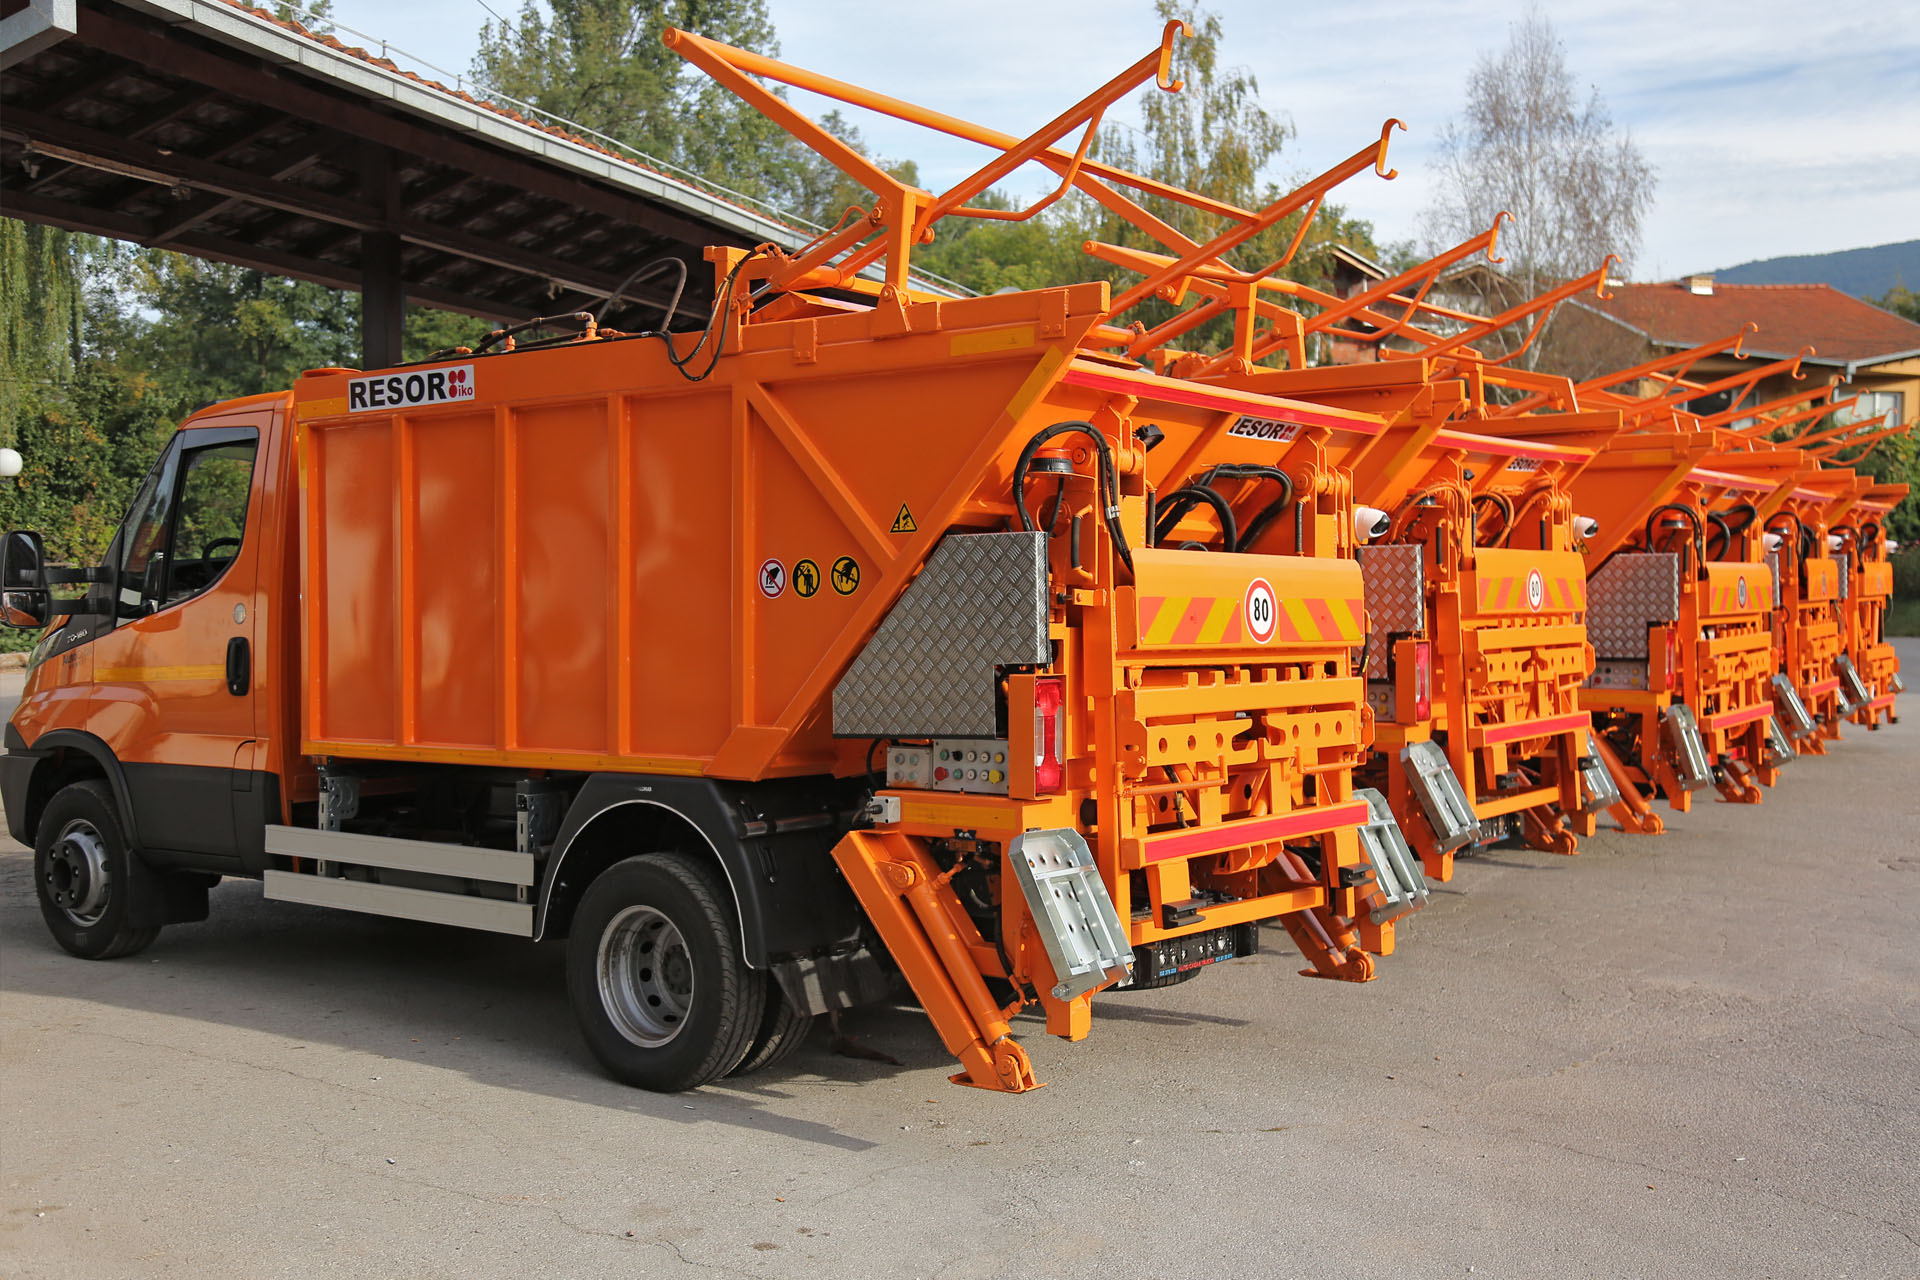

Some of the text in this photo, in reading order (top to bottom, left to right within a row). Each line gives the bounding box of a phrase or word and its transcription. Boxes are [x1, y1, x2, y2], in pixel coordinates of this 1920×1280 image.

[350, 372, 473, 409] RESOR iko
[1254, 597, 1269, 622] 80
